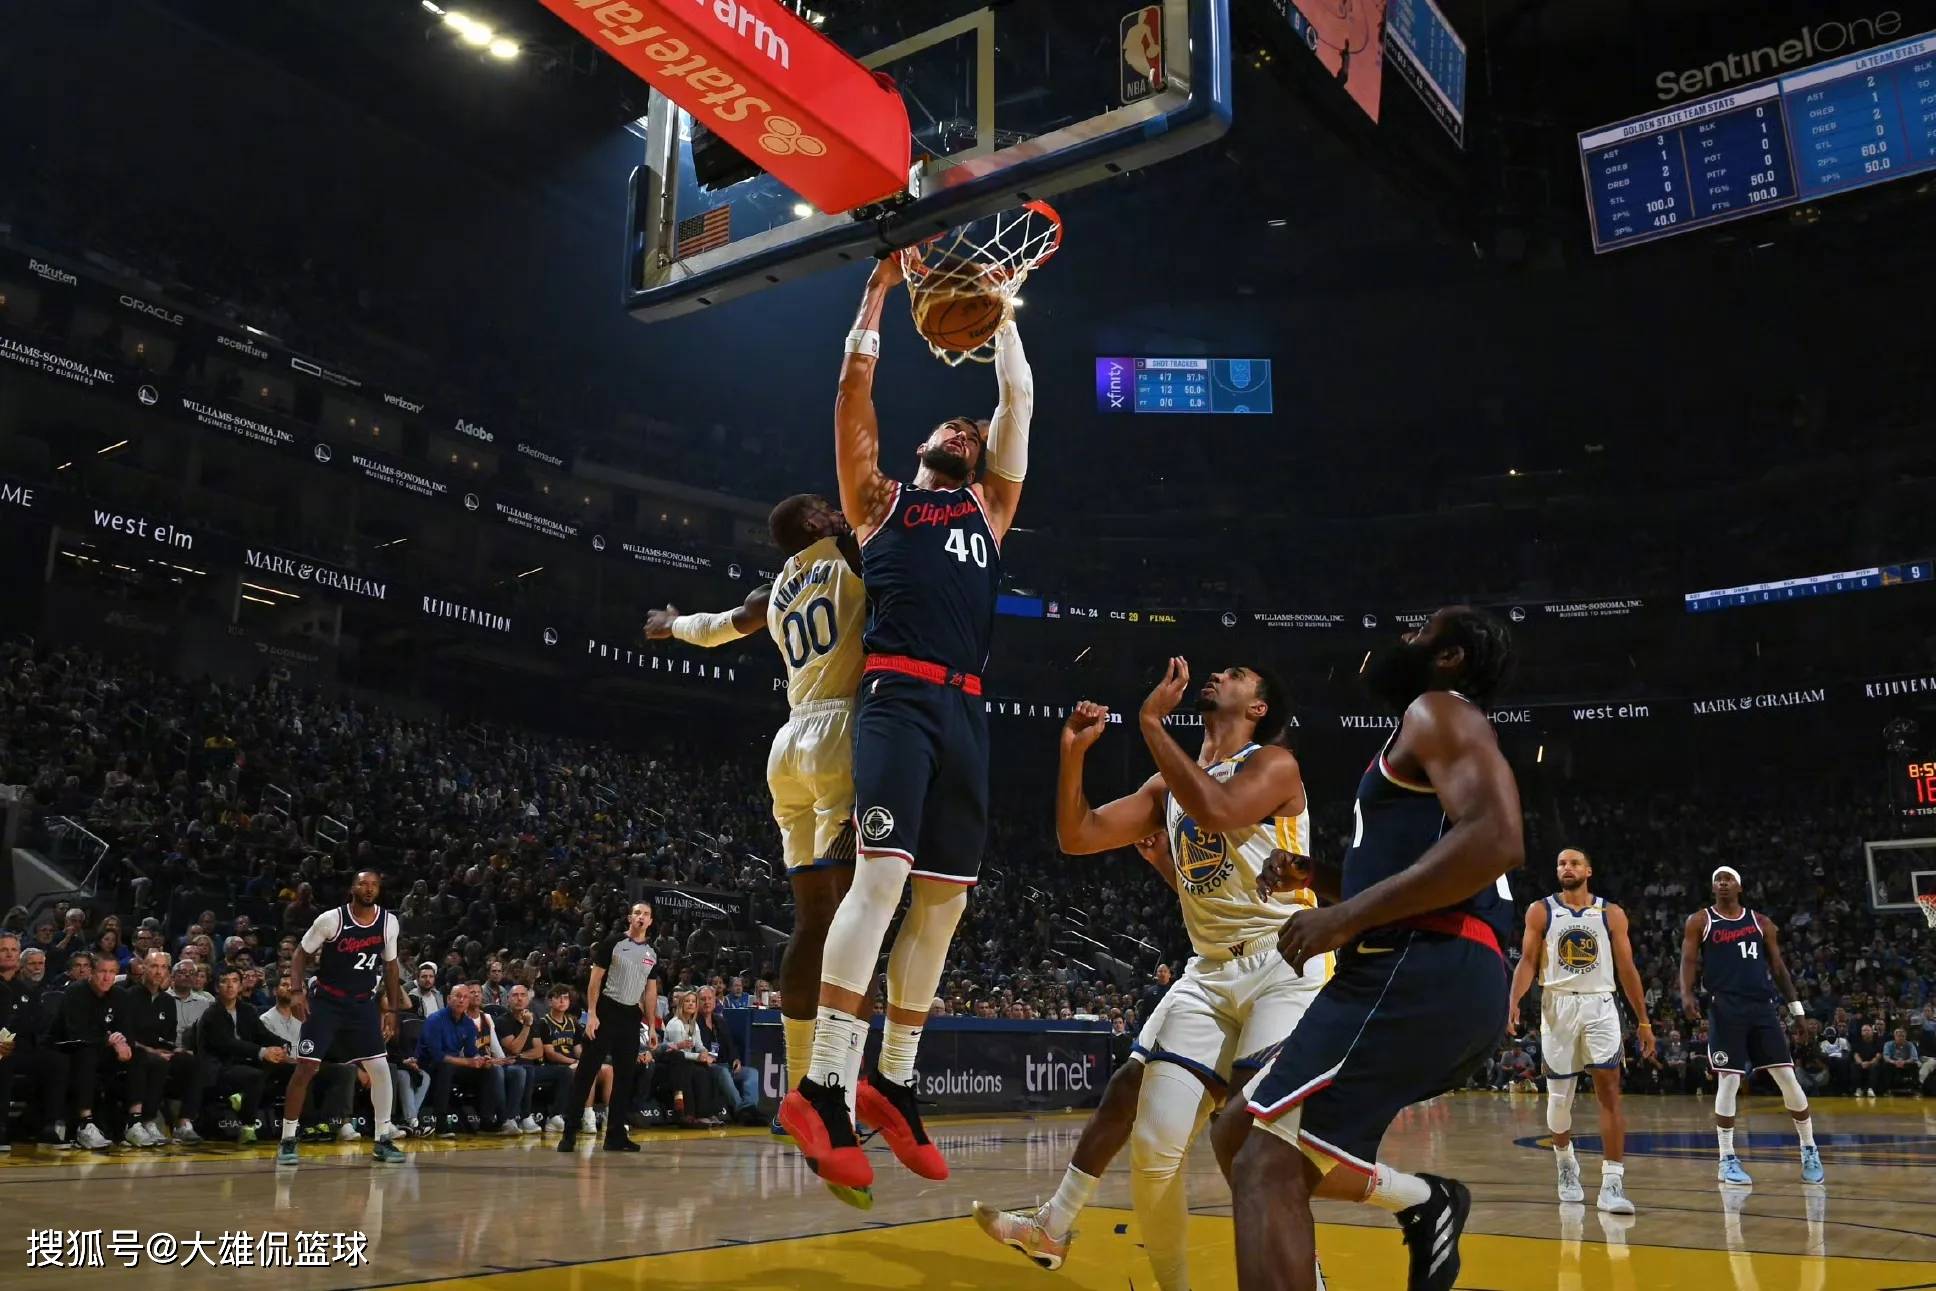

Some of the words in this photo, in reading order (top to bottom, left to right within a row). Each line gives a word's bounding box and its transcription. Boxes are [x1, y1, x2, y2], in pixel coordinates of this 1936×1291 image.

[1655, 10, 1902, 100] SentinelOne
[1856, 57, 1868, 70] LA
[1869, 52, 1894, 67] TEAM
[1894, 43, 1926, 59] STATS
[1127, 79, 1146, 97] NBA
[1807, 92, 1824, 103] AST
[1867, 76, 1876, 88] 2
[1756, 107, 1764, 117] 0
[1809, 106, 1835, 118] OREB
[1872, 92, 1878, 103] 1
[1873, 109, 1882, 120] 2
[1623, 119, 1655, 137] GOLDEN
[1656, 111, 1683, 128] STATE
[1684, 104, 1707, 120] TEAM
[1707, 97, 1736, 114] STATS
[1761, 123, 1766, 133] 1
[1877, 125, 1885, 136] 0
[1603, 149, 1619, 159] AST
[1657, 136, 1664, 146] 3
[1661, 150, 1667, 160] 1
[1762, 139, 1769, 149] 0
[1862, 141, 1887, 157] 60.0
[1765, 154, 1772, 165] 0
[1865, 158, 1891, 174] 50.0
[1662, 166, 1670, 176] 2
[1664, 182, 1672, 192] 0
[1748, 187, 1778, 203] 100.0
[1646, 197, 1674, 212] 100.0
[1653, 212, 1677, 227] 40.0
[28, 258, 78, 287] Rakuten
[119, 295, 184, 326] ORACLE
[216, 334, 269, 360] accenture
[0, 349, 40, 368] BUSINESS
[43, 363, 54, 372] TO
[56, 368, 94, 385] BUSINESS
[1107, 361, 1125, 408] xfinity
[1161, 386, 1173, 395] 1/2
[383, 392, 420, 414] verizon
[198, 414, 232, 431] BUSINESS
[234, 427, 244, 435] TO
[245, 430, 277, 446] BUSINESS
[454, 418, 494, 442] Adobe
[517, 443, 563, 466] ticketmaster
[0, 483, 34, 508] ME
[903, 500, 978, 528] Clippers
[94, 509, 148, 537] west
[154, 525, 193, 550] elm
[944, 528, 988, 568] 40
[244, 549, 296, 578] MARK
[298, 563, 314, 580] &
[315, 567, 387, 600] GRAHAM
[1911, 566, 1921, 579] 9
[422, 595, 511, 633] REJUVENATION
[1070, 607, 1086, 617] BAL
[1088, 608, 1099, 618] 24
[1110, 611, 1126, 620] CLE
[1149, 614, 1177, 623] FINAL
[783, 597, 838, 669] 00
[1865, 677, 1936, 699] REJUVENA
[1572, 705, 1613, 721] west
[1618, 703, 1650, 719] elm
[1693, 700, 1738, 715] MARK
[1739, 695, 1753, 710] &
[1755, 688, 1826, 709] GRAHAM
[1487, 710, 1531, 723] HOME
[1579, 938, 1593, 950] 30
[1737, 941, 1759, 960] 14
[353, 952, 378, 970] 24
[1558, 958, 1600, 975] WARRIORS
[926, 1068, 1002, 1095] solutions
[1025, 1052, 1092, 1092] trinet
